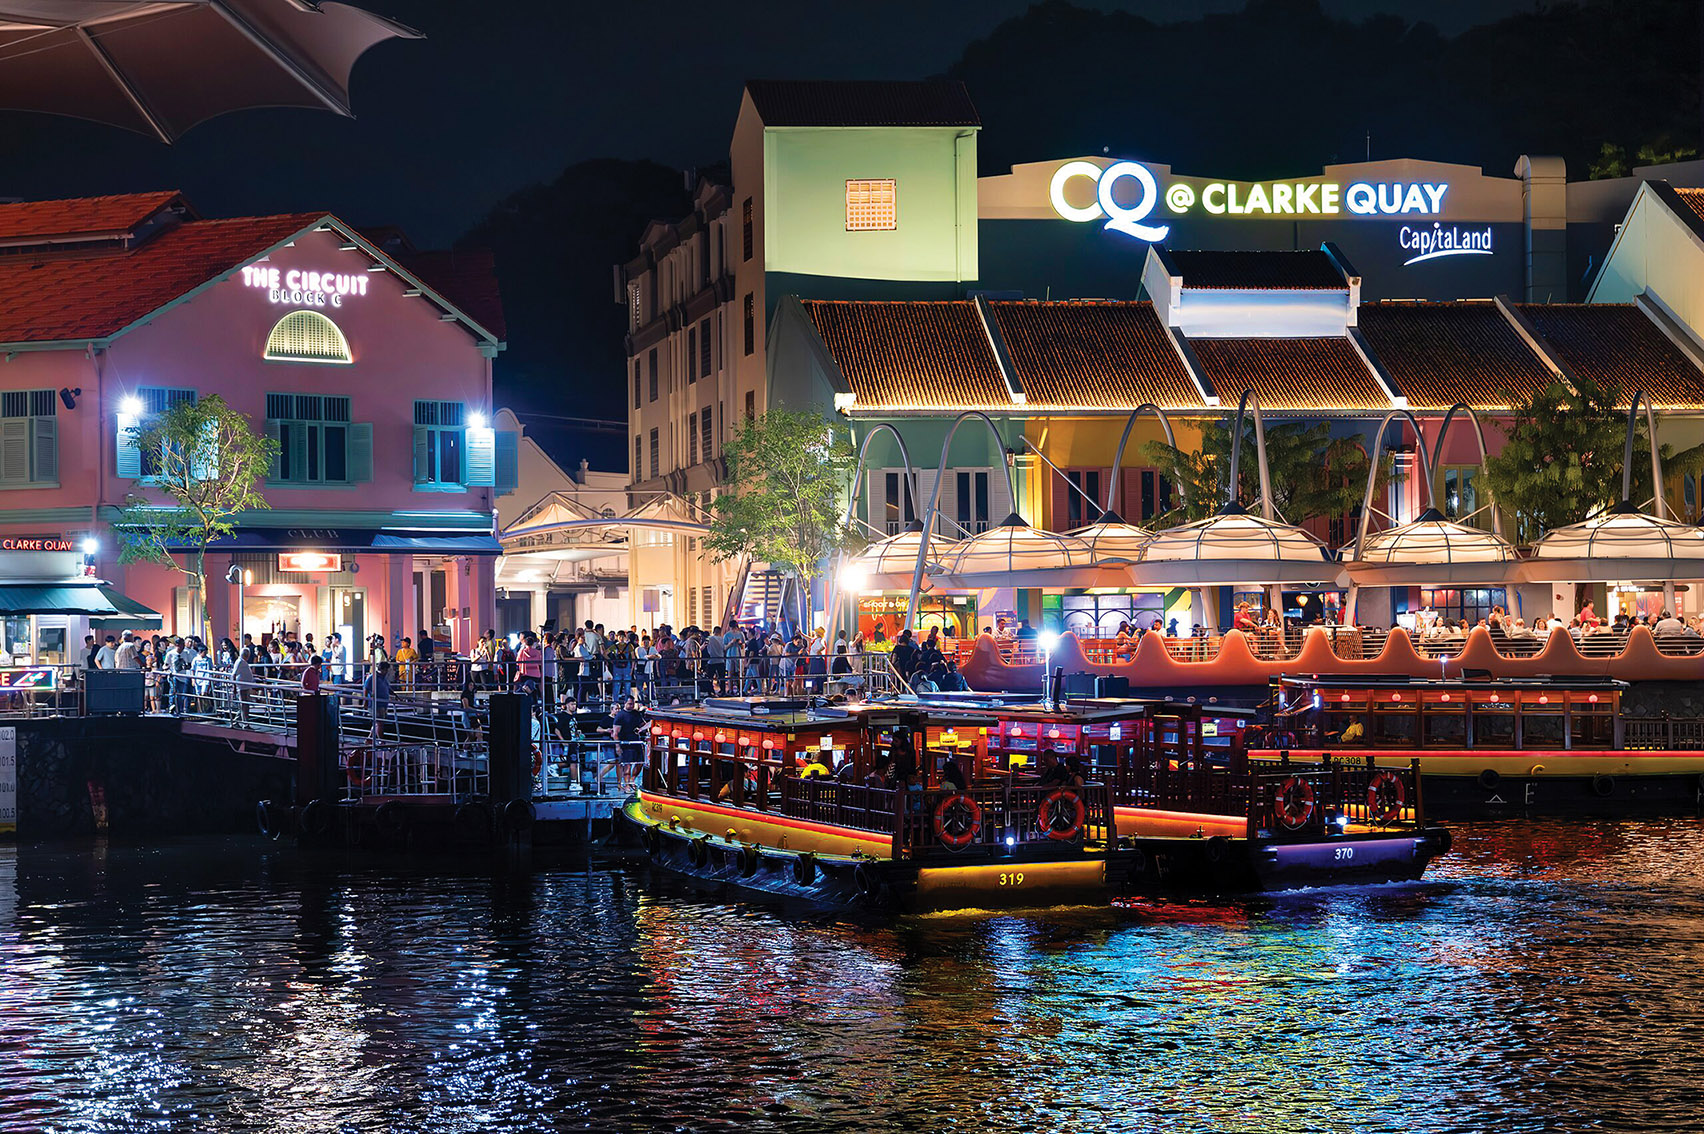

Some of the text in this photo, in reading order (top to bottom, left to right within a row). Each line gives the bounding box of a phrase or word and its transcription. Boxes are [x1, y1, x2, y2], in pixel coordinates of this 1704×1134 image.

[1049, 160, 1449, 243] CQ @ CLARKE QUAY
[1399, 222, 1493, 255] CapitaLand
[241, 266, 370, 296] THE CIRCUIT
[271, 289, 342, 306] BLOCK C
[287, 529, 340, 539] CLUB
[2, 539, 73, 551] CLARKE QUAY
[0, 730, 15, 740] 02.0
[1334, 847, 1354, 860] 370
[999, 872, 1025, 886] 319
